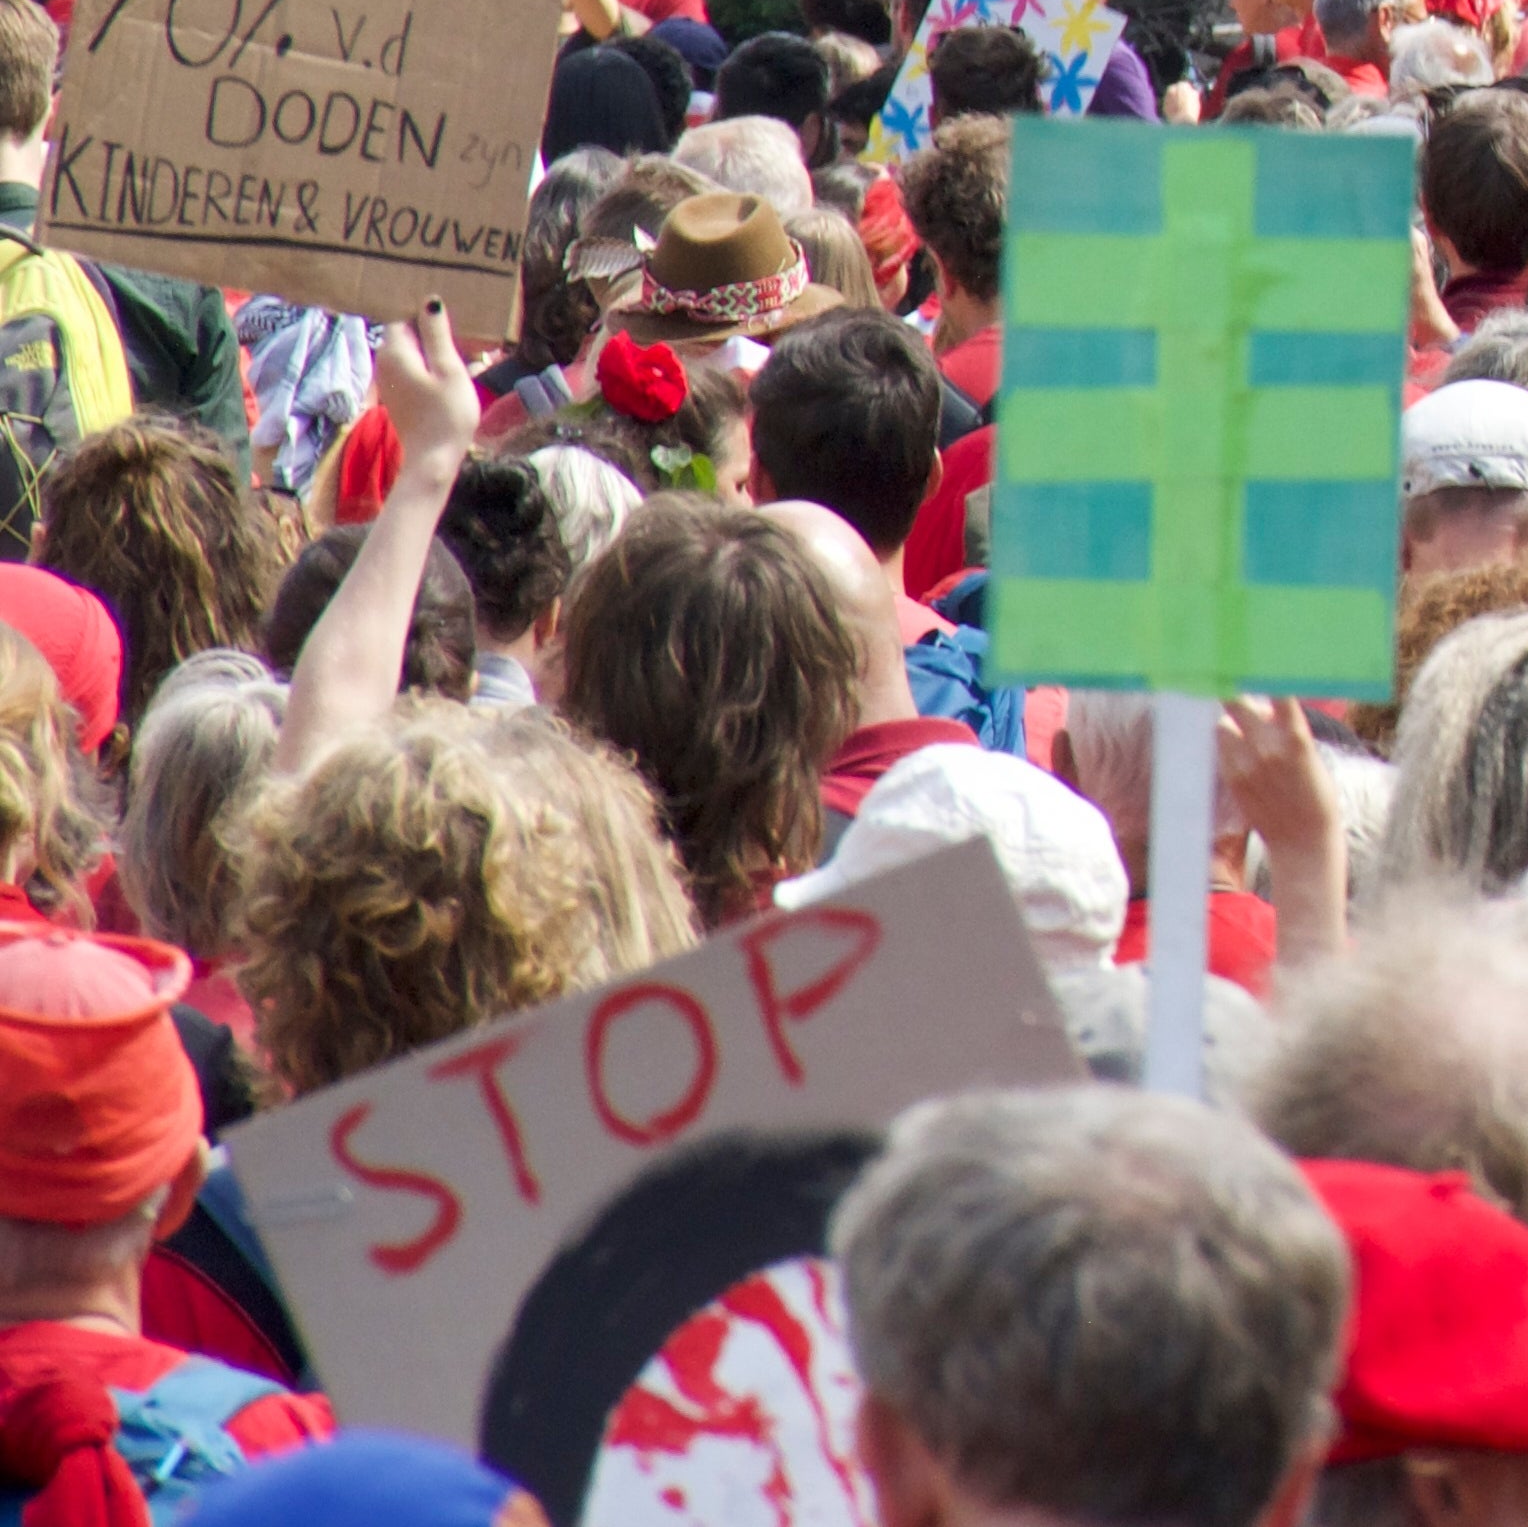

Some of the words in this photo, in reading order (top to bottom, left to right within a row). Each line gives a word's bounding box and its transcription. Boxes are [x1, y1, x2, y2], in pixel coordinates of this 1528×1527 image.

[206, 75, 447, 169] DODEN
[50, 123, 286, 227] KINDEREN
[293, 179, 321, 235] &
[344, 191, 522, 265] VROUWEN
[330, 907, 882, 1276] STOP
